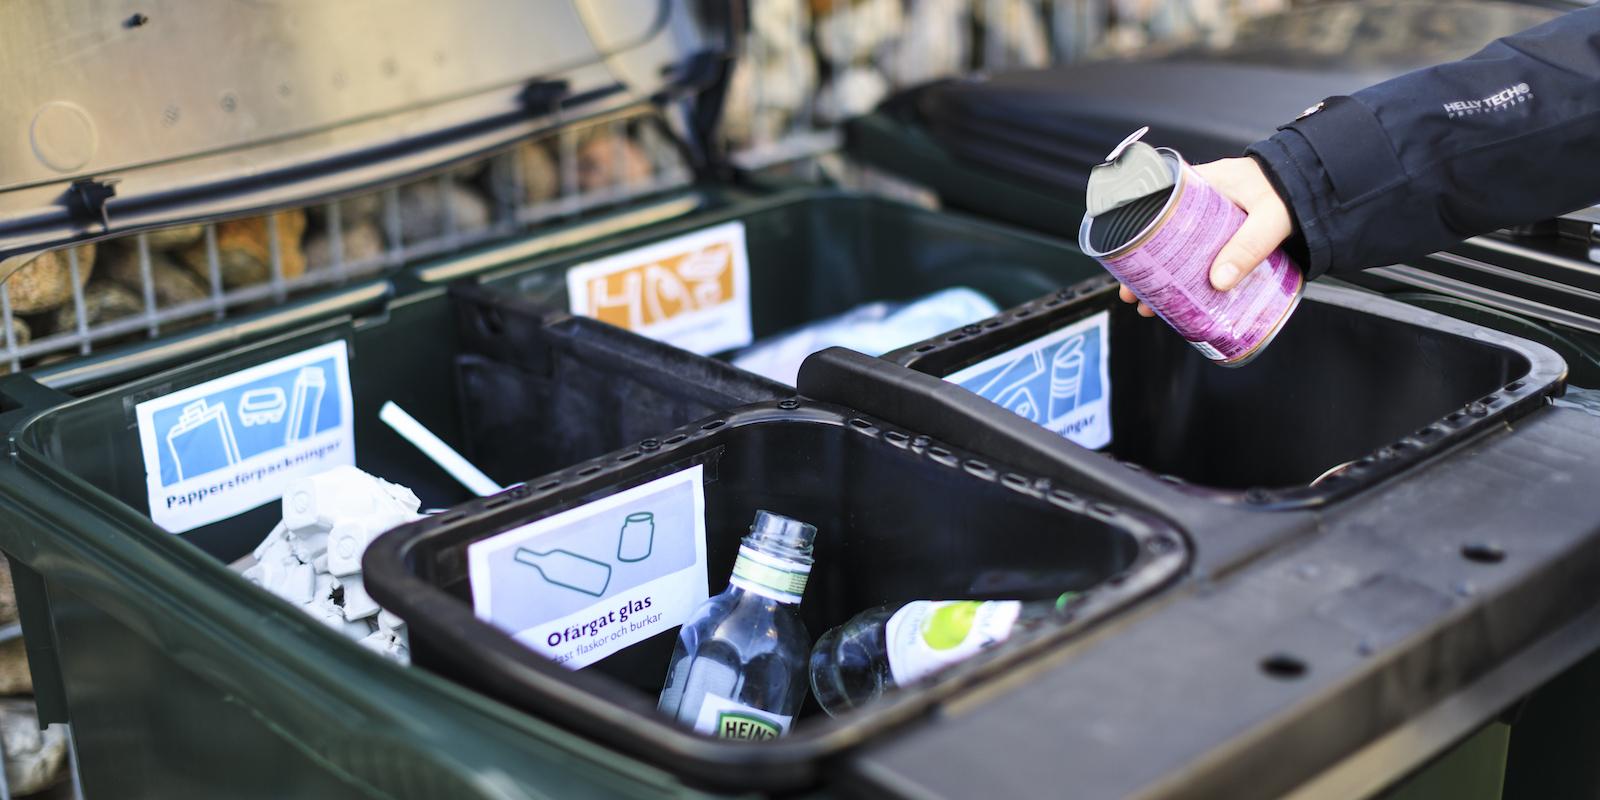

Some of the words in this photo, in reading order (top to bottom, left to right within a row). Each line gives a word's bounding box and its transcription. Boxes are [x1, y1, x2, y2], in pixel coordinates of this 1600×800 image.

[1443, 100, 1481, 112] HELLY
[166, 439, 342, 508] Pappersförpackningar
[547, 610, 615, 648] Ofärgat
[619, 596, 652, 623] glas
[576, 636, 609, 657] flaskor
[610, 625, 628, 641] och
[630, 612, 663, 632] burkar
